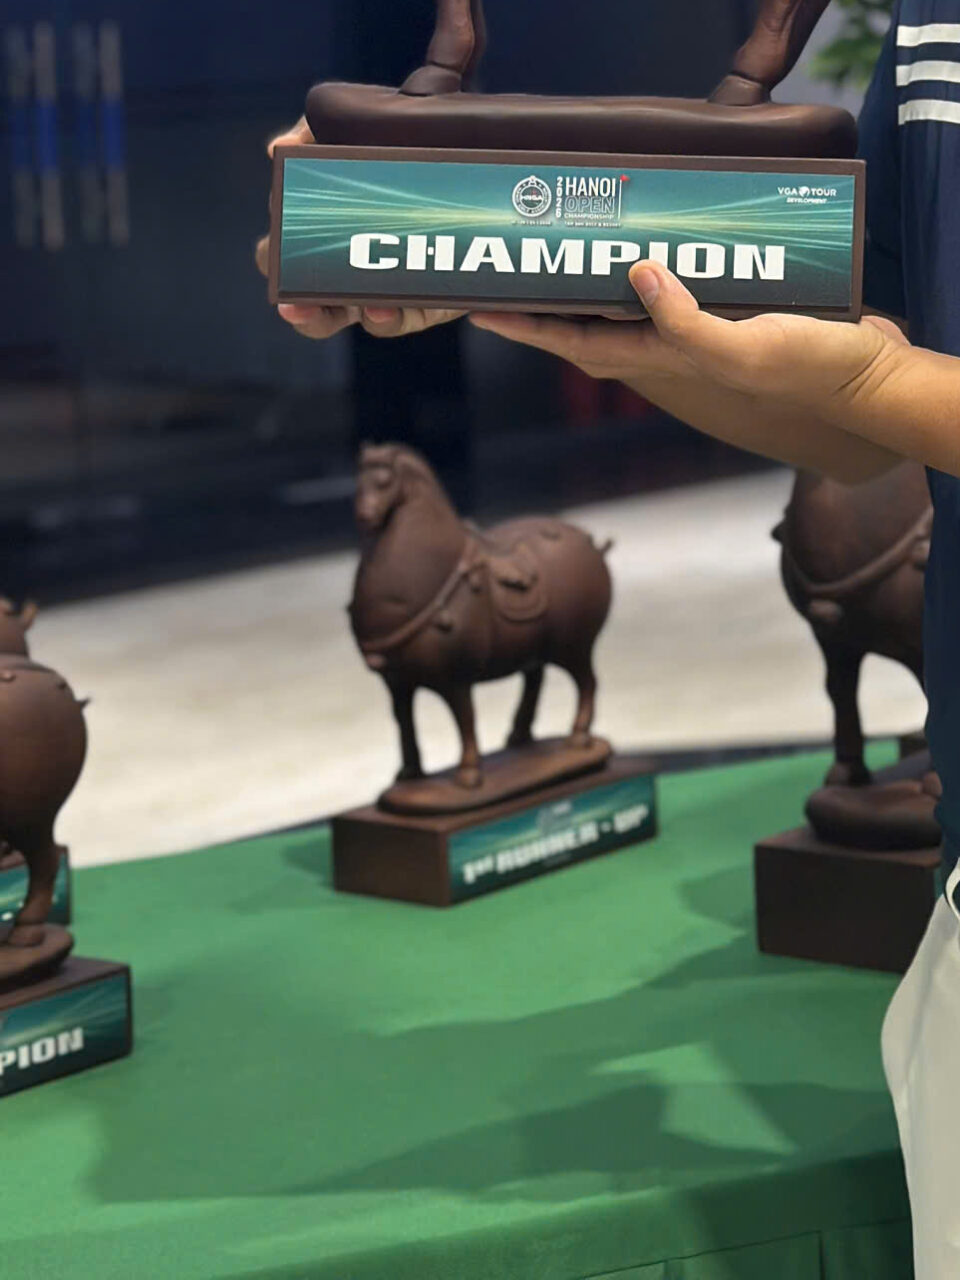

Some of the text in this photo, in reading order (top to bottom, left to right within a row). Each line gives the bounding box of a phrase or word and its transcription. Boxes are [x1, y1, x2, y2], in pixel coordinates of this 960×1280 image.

[565, 176, 617, 197] HANOI
[777, 186, 837, 197] VGA TOUR
[555, 176, 564, 219] 2026
[564, 195, 616, 214] OPEN
[349, 232, 786, 281] CHAMPION
